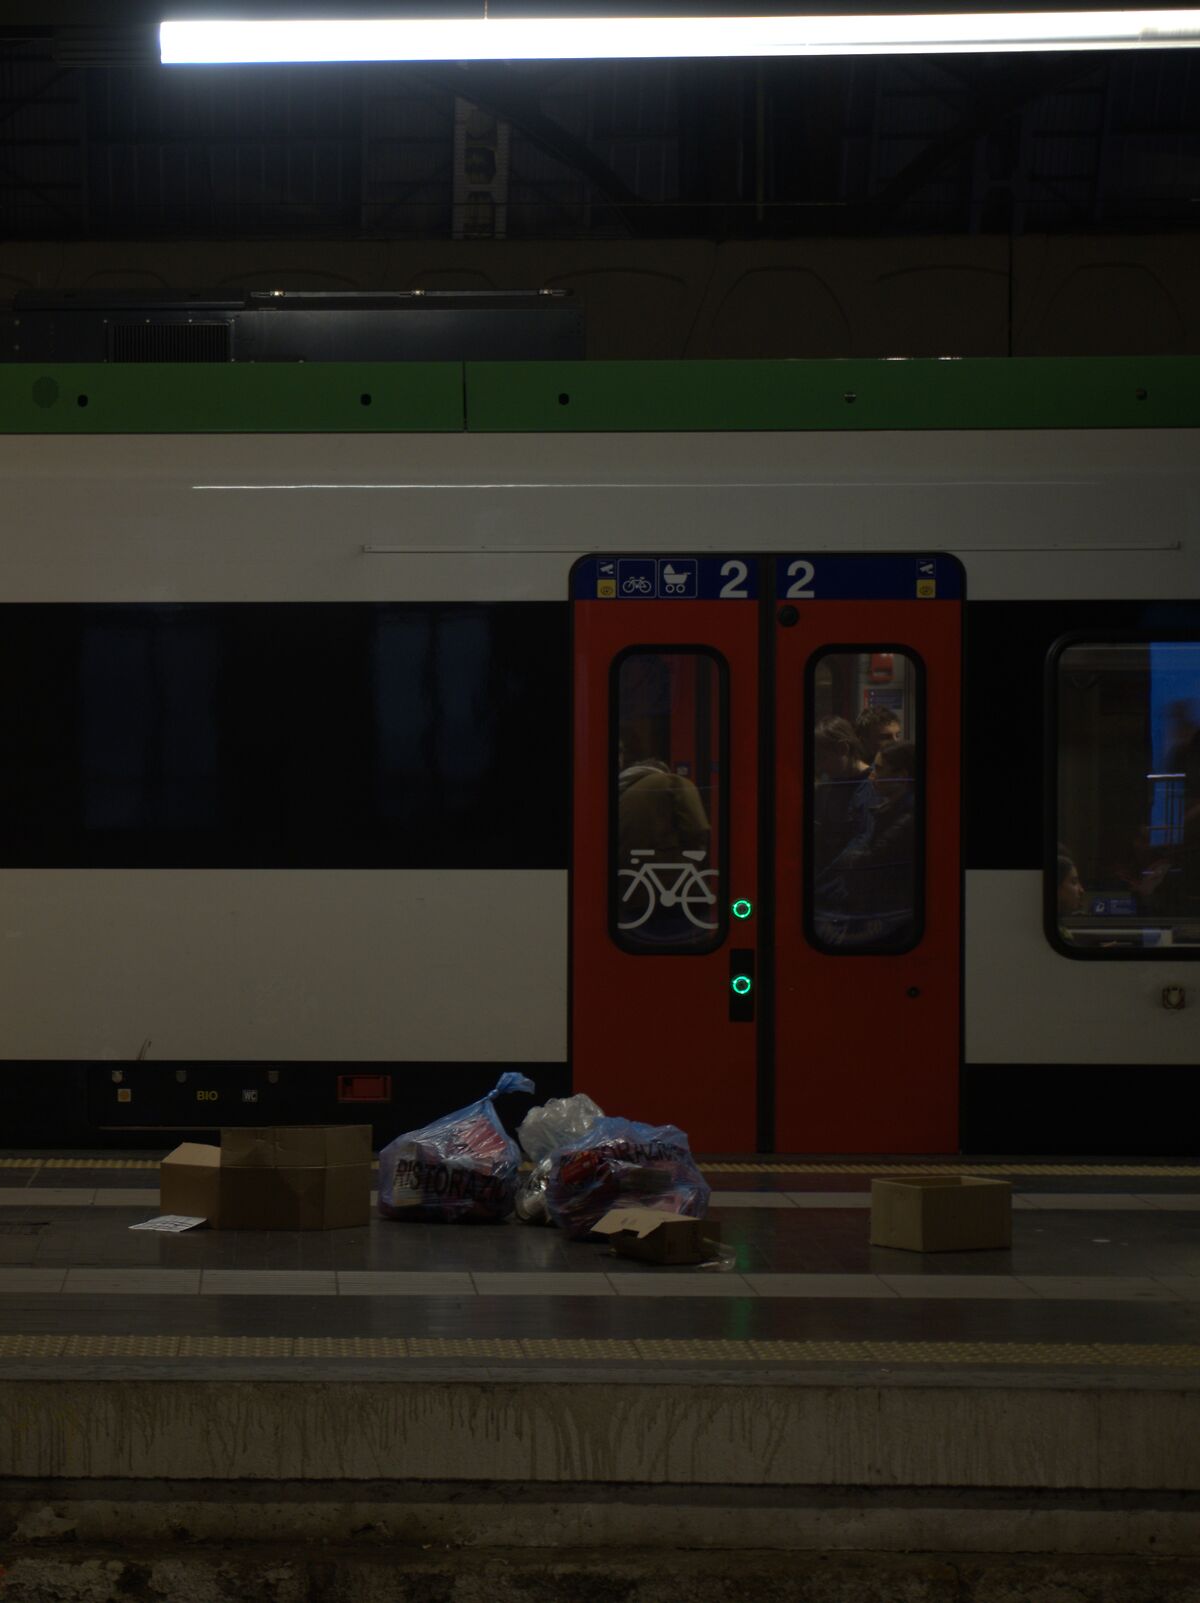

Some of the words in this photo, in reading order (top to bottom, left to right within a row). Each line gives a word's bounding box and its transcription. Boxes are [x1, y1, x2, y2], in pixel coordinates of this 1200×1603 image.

[719, 560, 748, 598] 2
[786, 560, 815, 598] 2
[196, 1090, 219, 1101] BIO
[242, 1089, 258, 1102] WC
